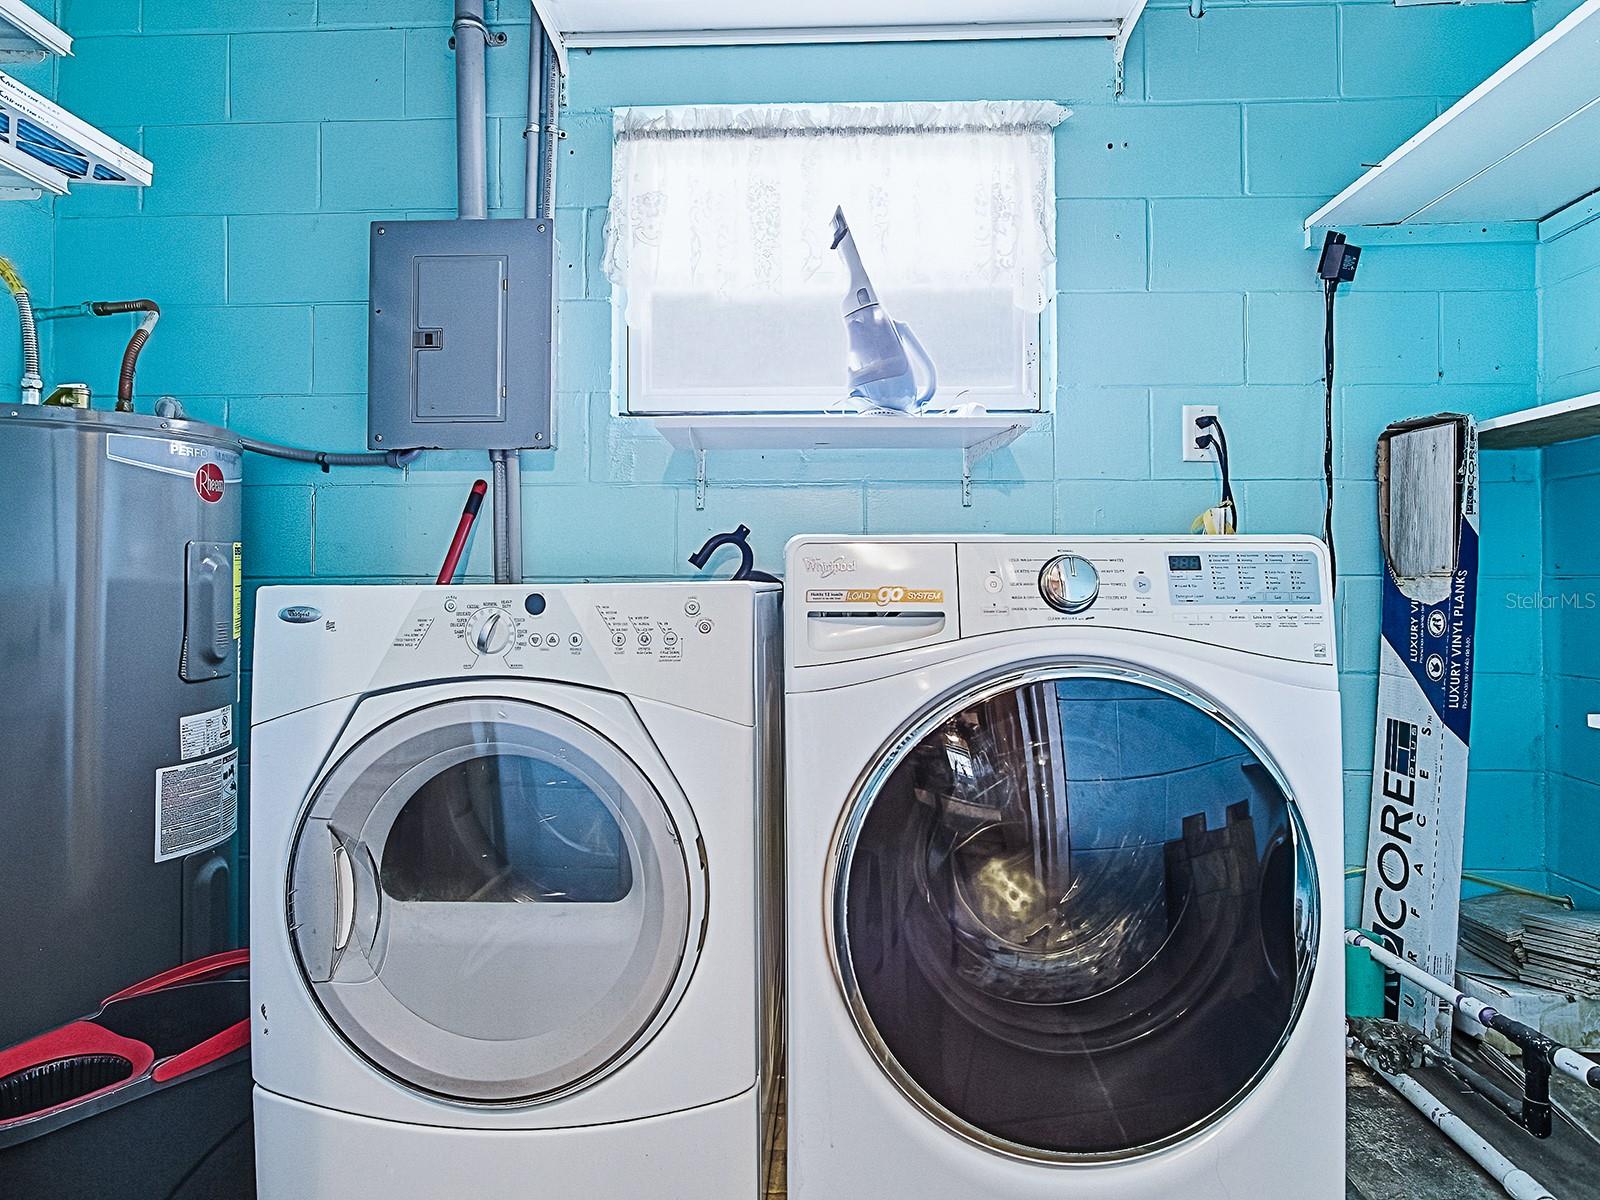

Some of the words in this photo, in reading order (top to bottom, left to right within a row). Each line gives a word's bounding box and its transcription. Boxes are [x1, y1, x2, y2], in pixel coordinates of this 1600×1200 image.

[199, 463, 224, 496] Rheem
[803, 556, 857, 578] Whirlpool
[847, 592, 871, 600] LOAD
[875, 586, 905, 606] go
[1453, 569, 1468, 617] PLANKS
[1410, 616, 1419, 662] LUXURY
[1451, 621, 1463, 658] VINYL
[1448, 660, 1461, 708] LUXURY
